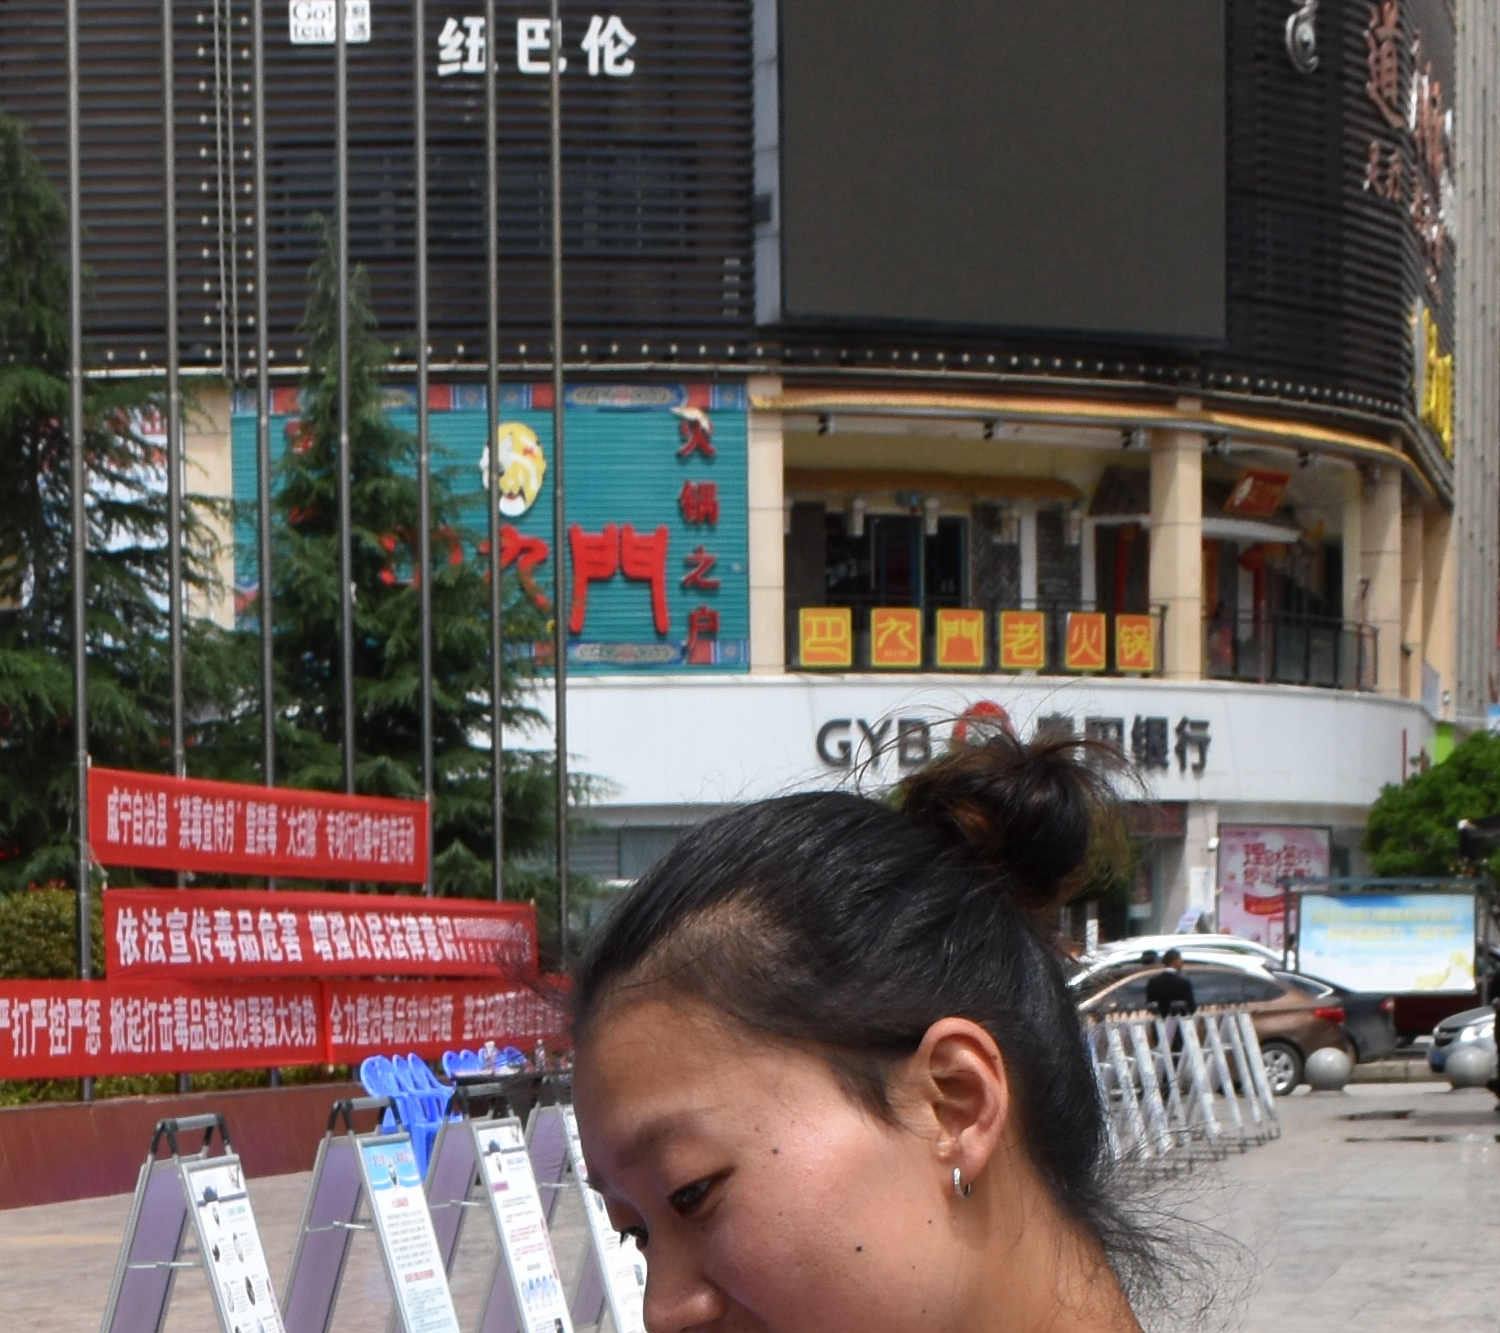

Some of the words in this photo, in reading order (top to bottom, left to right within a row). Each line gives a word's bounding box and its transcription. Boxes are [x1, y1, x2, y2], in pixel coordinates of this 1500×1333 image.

[437, 15, 637, 76] 纽巴伦
[115, 907, 303, 967] 依法宣传毒品危害
